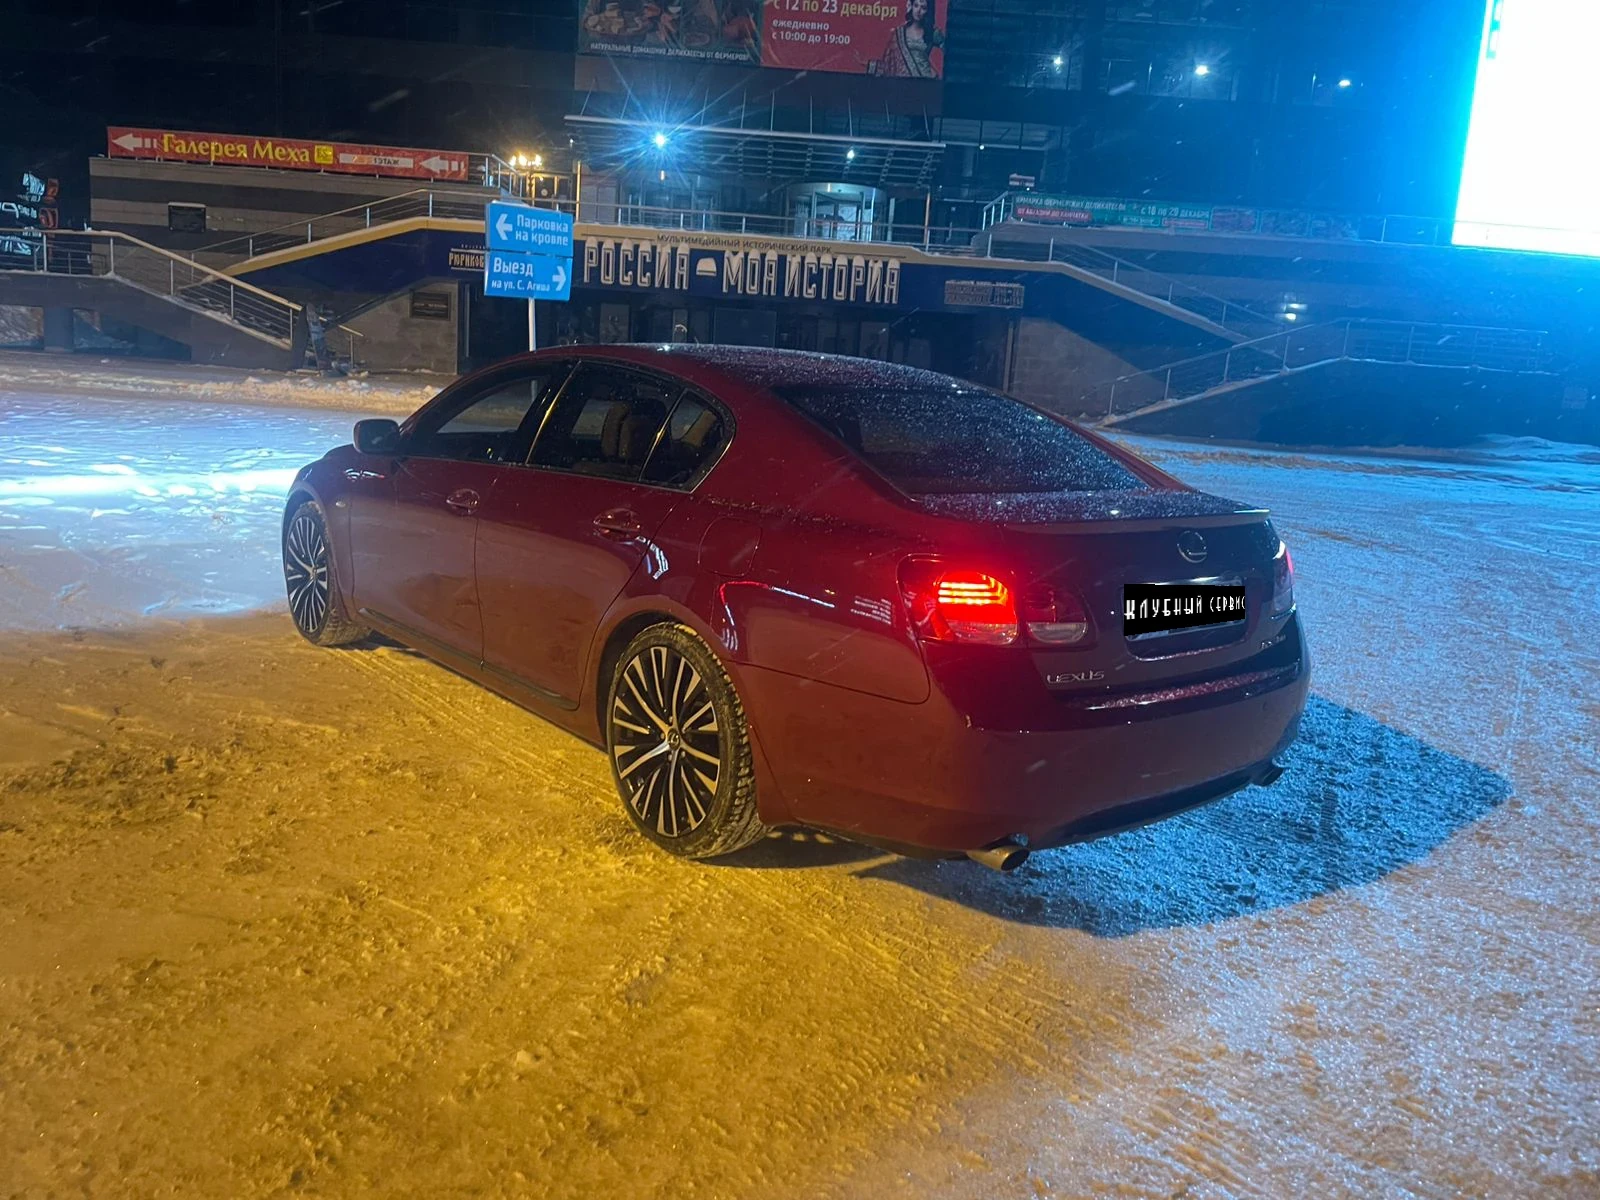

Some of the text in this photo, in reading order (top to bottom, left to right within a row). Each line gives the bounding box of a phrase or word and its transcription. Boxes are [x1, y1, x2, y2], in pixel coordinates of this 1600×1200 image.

[773, 0, 898, 20] с 12 по 23 декабря
[772, 19, 830, 31] ежедневно
[780, 31, 806, 42] 10:00
[808, 33, 821, 44] до
[824, 34, 850, 44] 19:00
[162, 134, 248, 159] Галерея
[253, 139, 310, 163] Меха
[517, 214, 569, 233] Парковка
[515, 231, 569, 246] на кровле
[656, 234, 832, 254] МУЛЬТИМЕДИЙНЫЙ ИСТОРИЧЕСКИЙ ПАРК
[493, 257, 534, 277] Выезд
[583, 236, 690, 290] РОССИЯ
[722, 248, 777, 297] МОЯ
[784, 251, 900, 304] ИСТОРИЯ
[491, 279, 550, 292] на ул. С. Агиша
[1046, 669, 1105, 685] LEXUS
